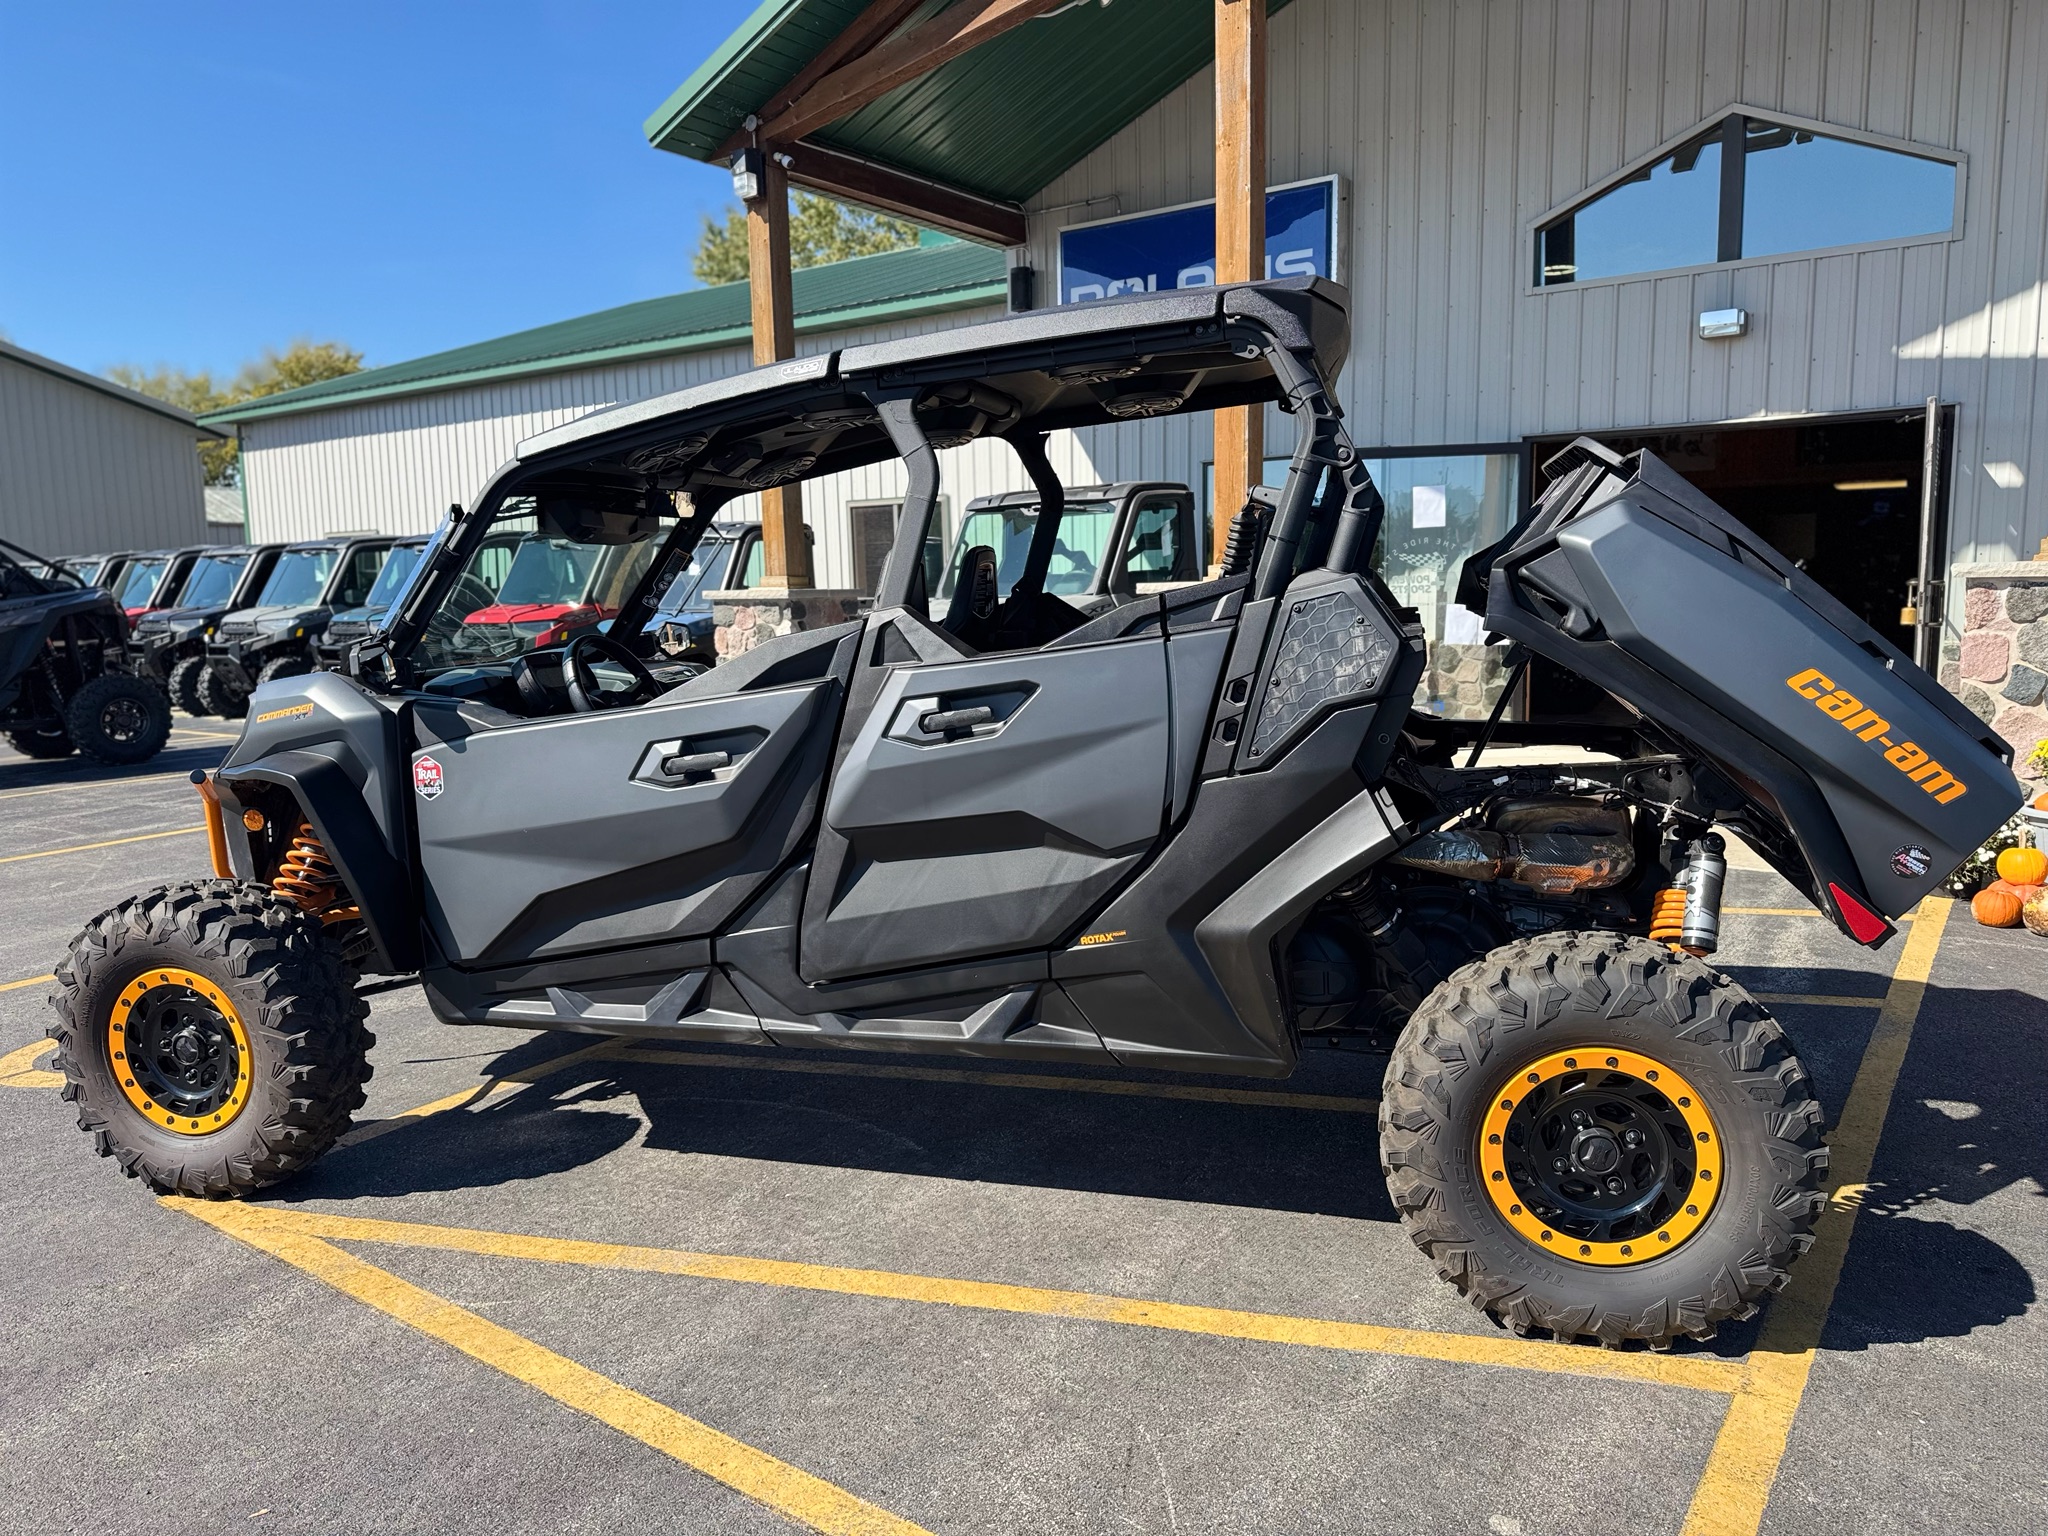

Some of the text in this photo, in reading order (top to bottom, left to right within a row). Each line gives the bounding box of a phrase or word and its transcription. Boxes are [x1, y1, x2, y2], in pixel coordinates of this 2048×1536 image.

[1088, 603, 1112, 615] XP
[256, 703, 314, 723] COMMANDER
[1786, 667, 1968, 805] can-am
[416, 768, 439, 780] TRAIL
[420, 786, 441, 795] SERIES
[1684, 869, 1704, 917] FOX
[1080, 933, 1114, 945] ROTAX
[1454, 1146, 1565, 1288] TRAC FORCE
